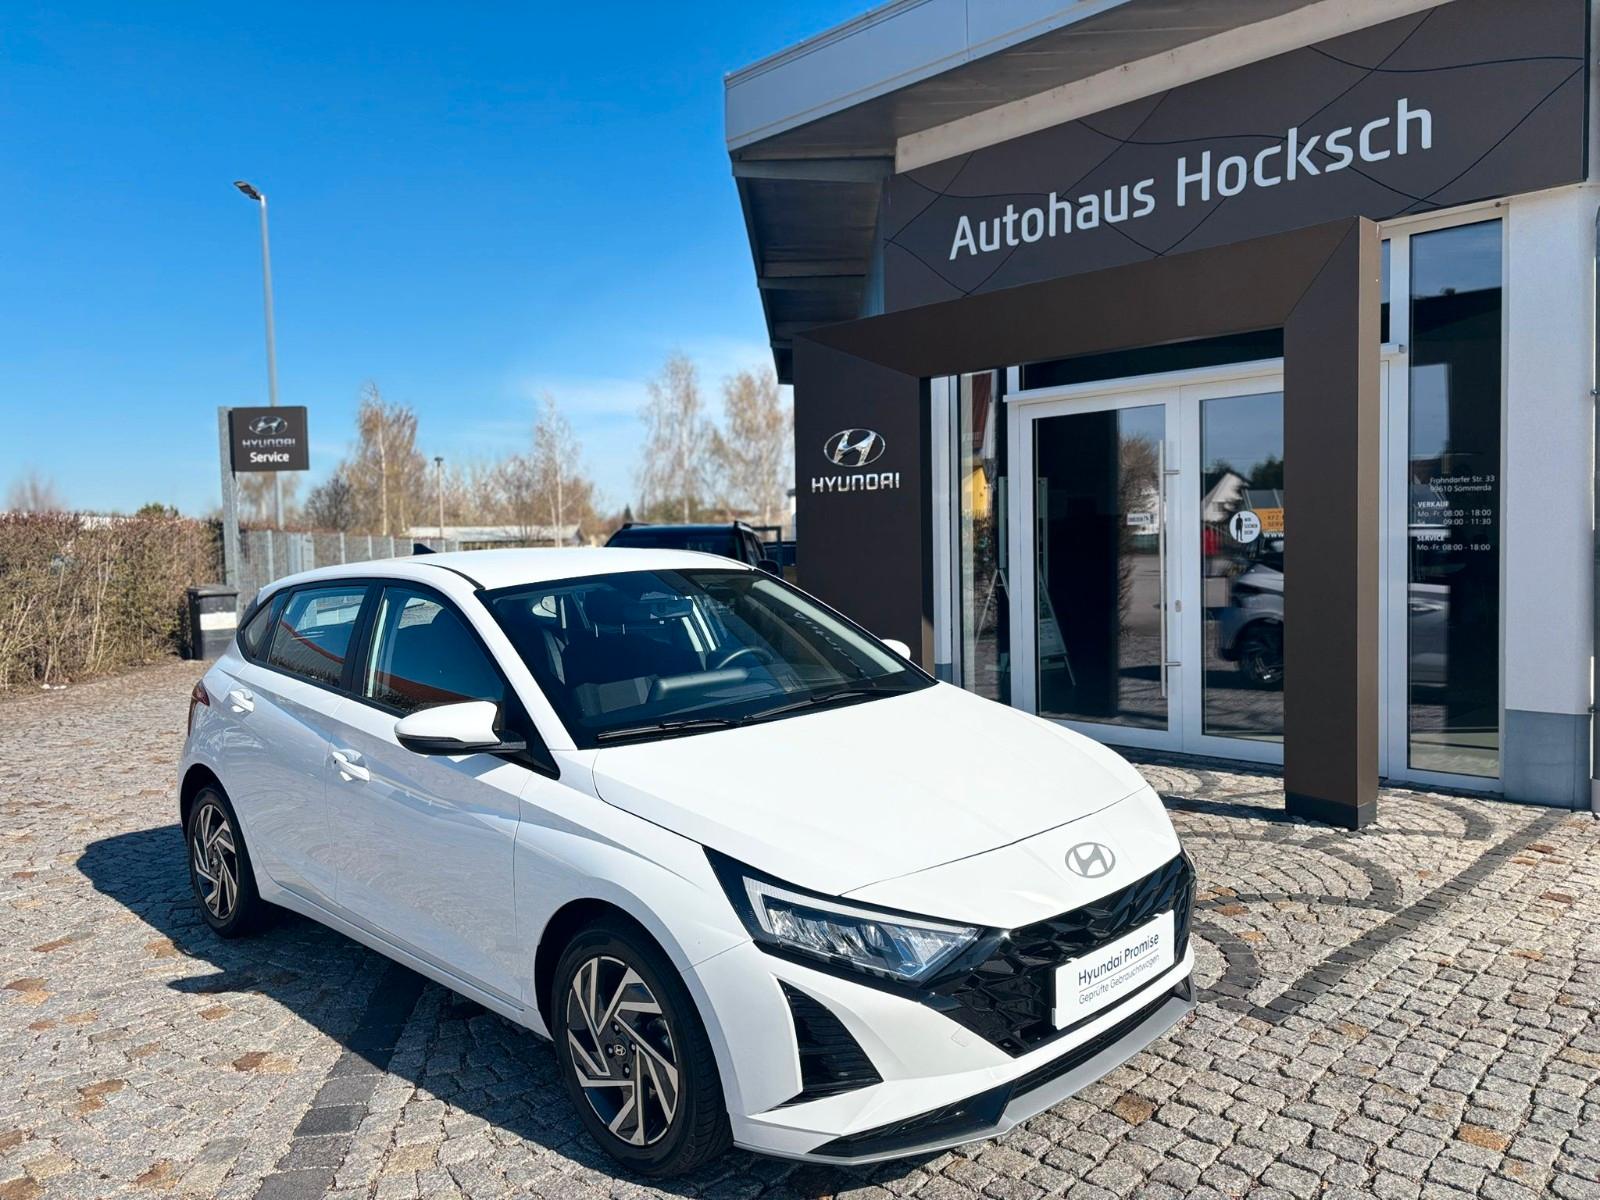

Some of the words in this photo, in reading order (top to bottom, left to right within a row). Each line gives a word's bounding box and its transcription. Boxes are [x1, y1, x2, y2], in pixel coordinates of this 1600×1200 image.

[949, 178, 1156, 261] Autohaus
[1176, 97, 1433, 207] Hocksch
[242, 438, 296, 448] HYUNDAI
[249, 451, 290, 463] Service
[811, 472, 900, 493] HYUNDAI
[1486, 474, 1496, 482] 33
[1417, 500, 1449, 508] VERKAUF
[1416, 534, 1446, 542] SERVICE
[1078, 950, 1123, 986] Hyundai
[1124, 933, 1160, 963] Promise
[1079, 983, 1110, 1005] Geprüfte
[1110, 953, 1160, 989] Gebrauchtwagen
